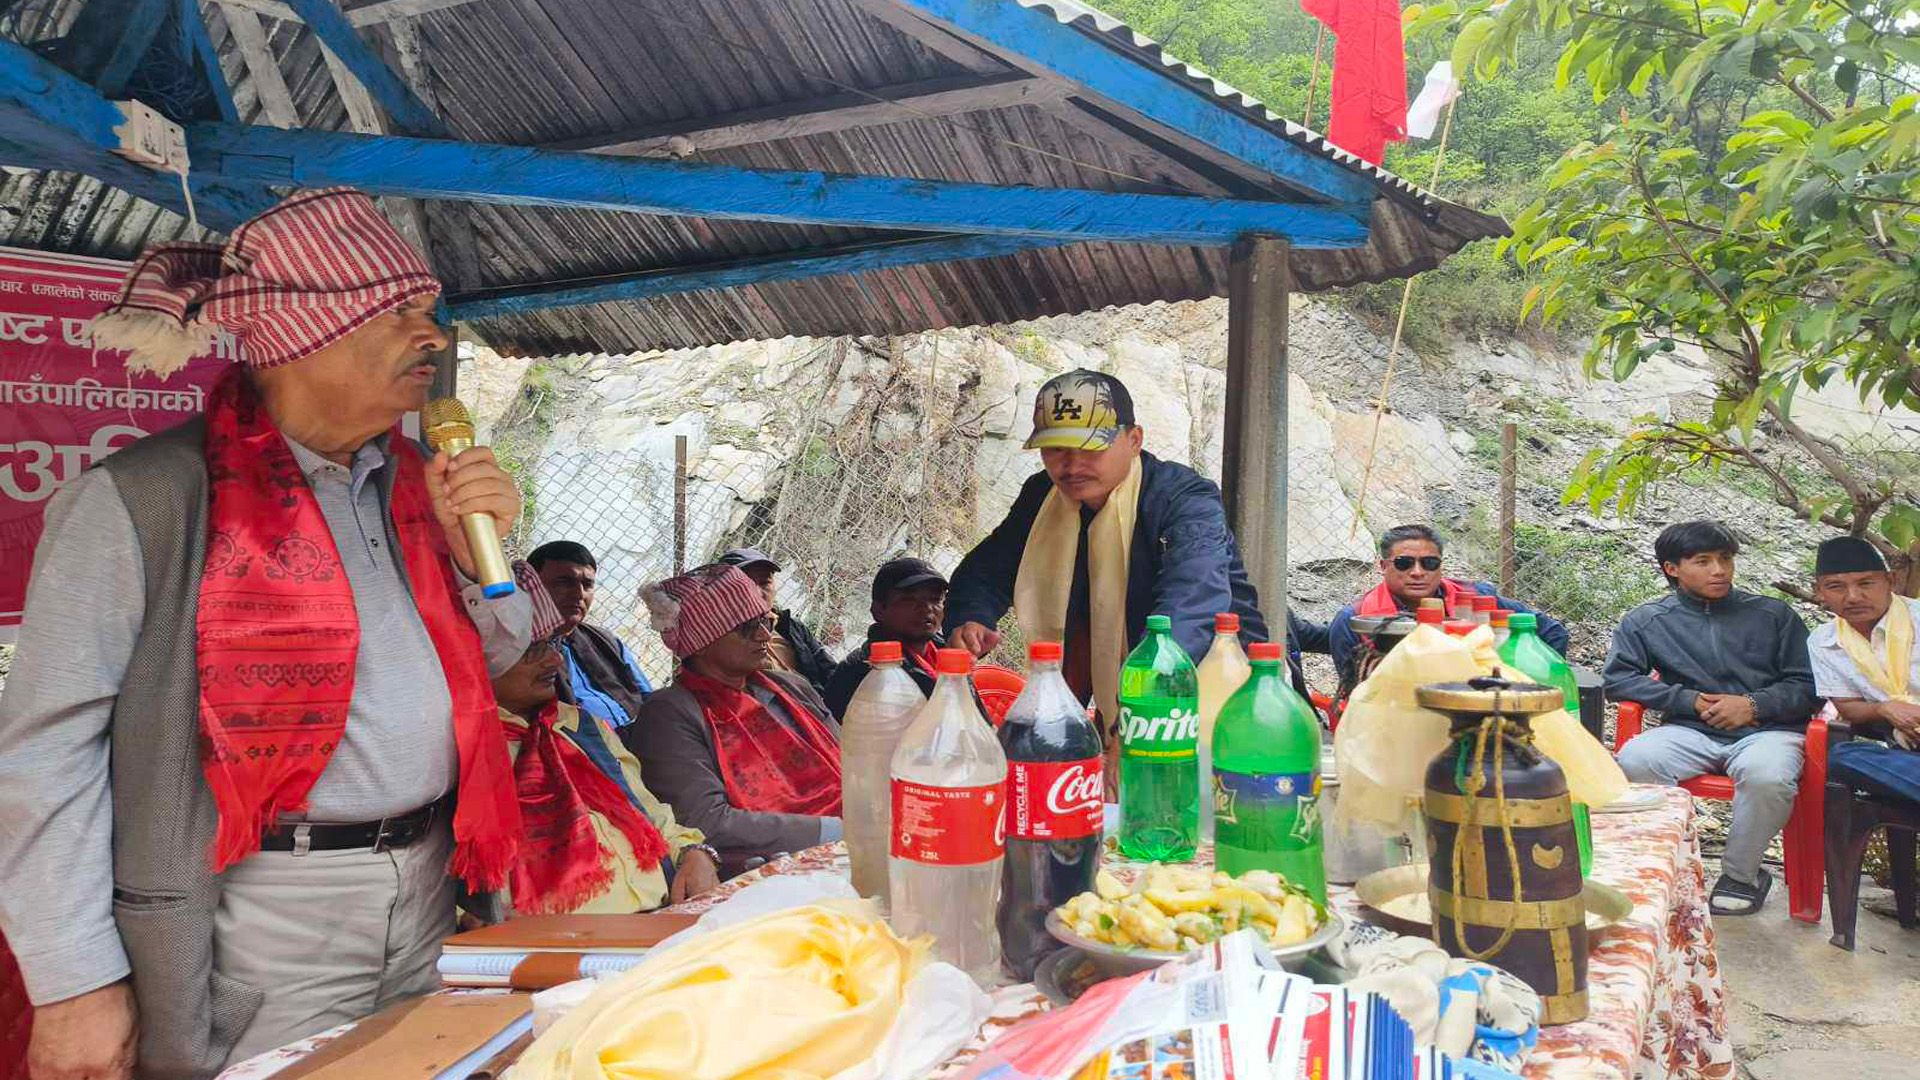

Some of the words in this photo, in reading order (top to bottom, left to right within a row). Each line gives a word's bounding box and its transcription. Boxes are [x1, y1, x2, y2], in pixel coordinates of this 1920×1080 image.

[0, 372, 205, 412] ाउँपालिकाको
[1052, 392, 1082, 421] LA
[1118, 706, 1200, 745] Sprite
[1016, 764, 1025, 783] ME
[904, 785, 941, 798] ORIGINAL
[943, 791, 971, 799] TASTE
[1016, 784, 1026, 836] RECYCLE
